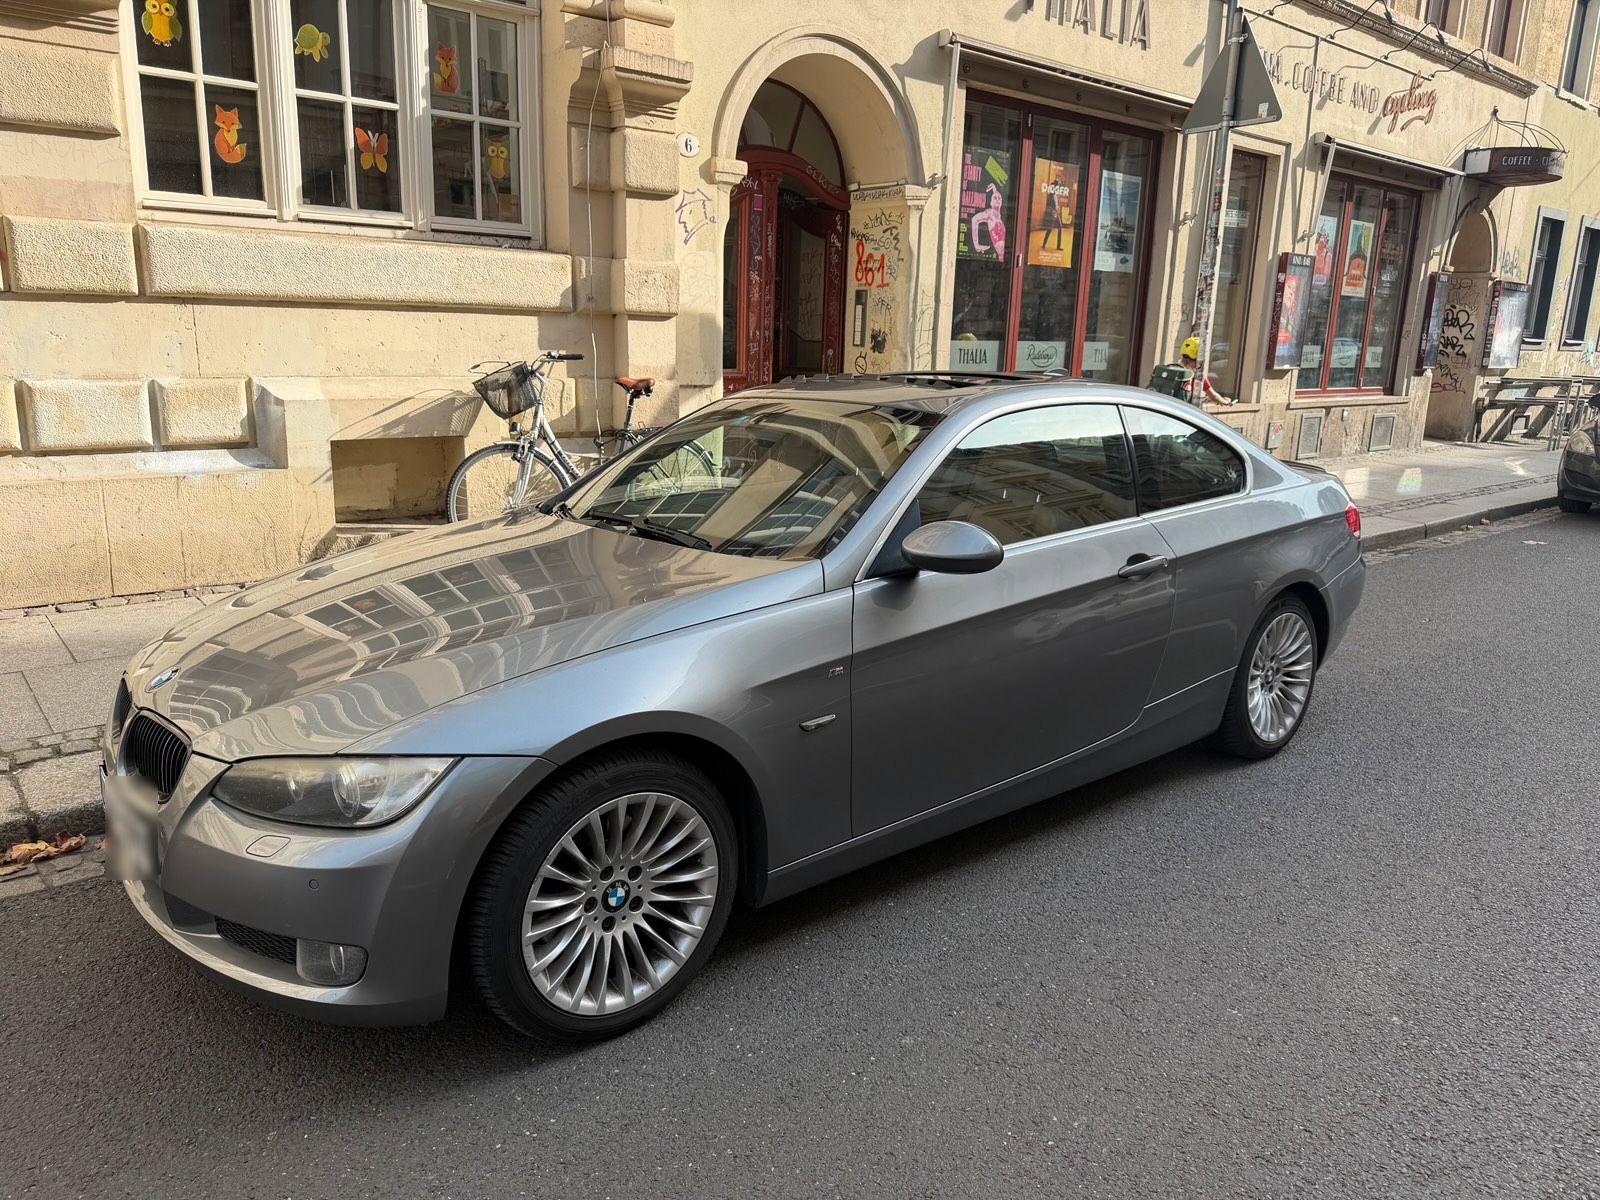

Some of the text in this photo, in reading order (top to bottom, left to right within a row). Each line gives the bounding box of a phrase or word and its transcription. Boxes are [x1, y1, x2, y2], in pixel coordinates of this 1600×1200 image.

[1026, 0, 1151, 50] ALIA
[1350, 81, 1380, 113] AND
[685, 138, 693, 153] 6
[1502, 155, 1531, 166] COFFEE
[1041, 183, 1070, 196] DIGGER
[958, 348, 987, 364] THALIA
